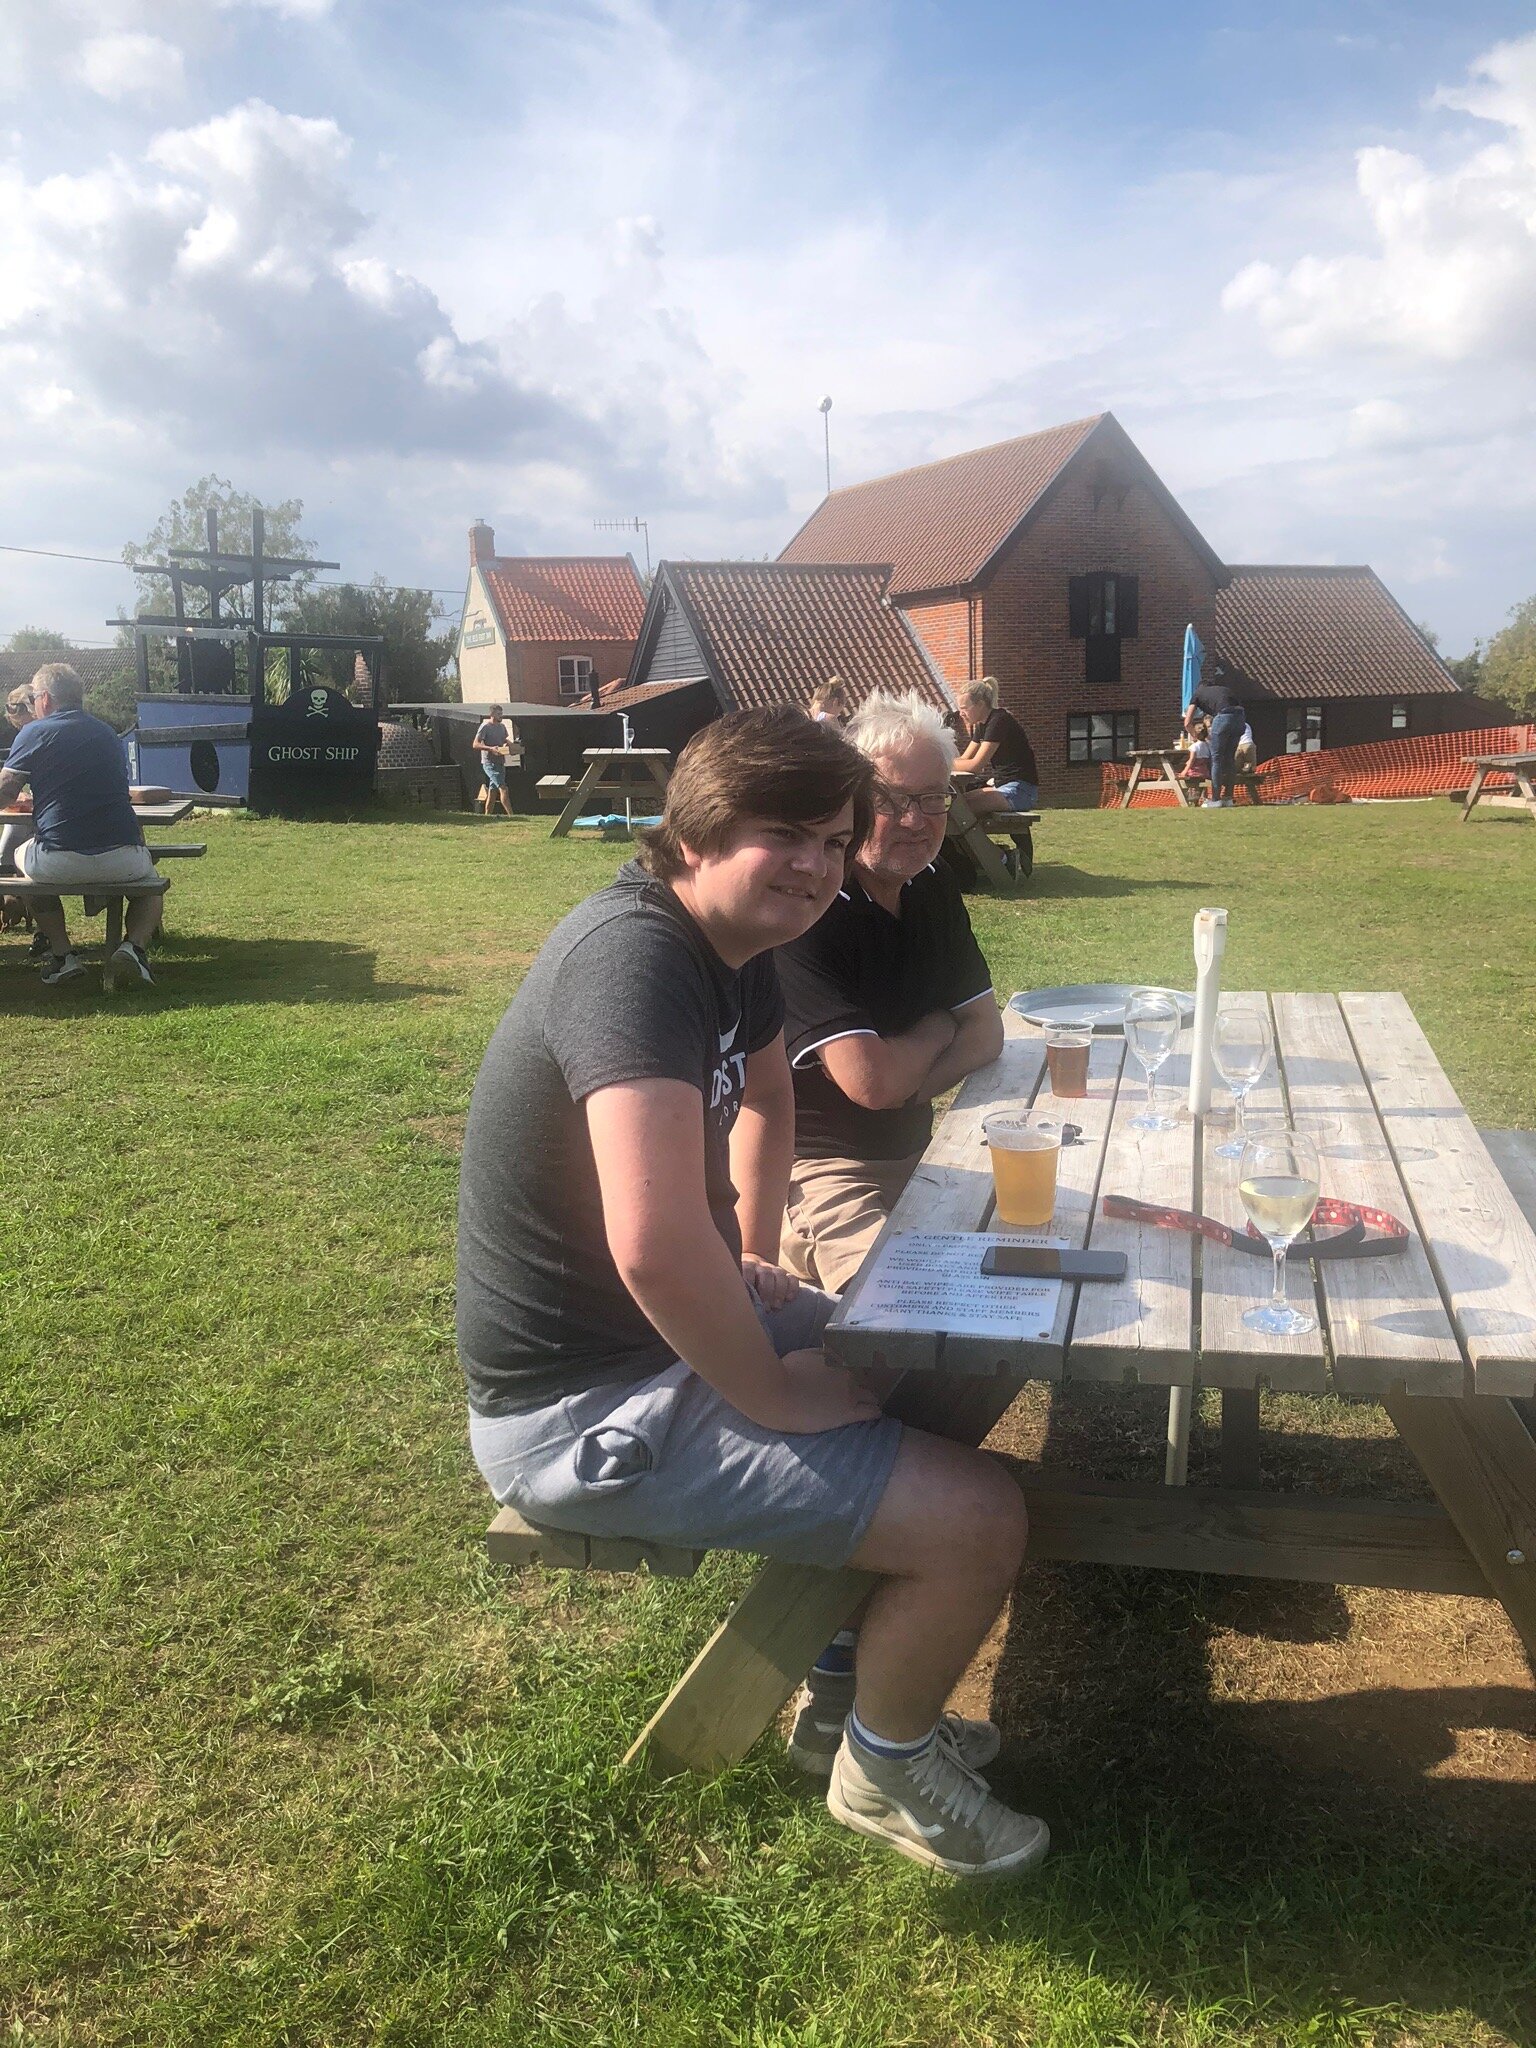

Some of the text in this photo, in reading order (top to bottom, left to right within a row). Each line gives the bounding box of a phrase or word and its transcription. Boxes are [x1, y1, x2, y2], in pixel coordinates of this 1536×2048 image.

[268, 745, 360, 762] GHOST SHIP
[977, 1237, 1049, 1245] REMINDER
[887, 1265, 935, 1273] PROVIDED
[936, 1300, 980, 1308] RESPECT
[917, 1309, 957, 1317] THANKS
[989, 1309, 1041, 1317] MEMBERS
